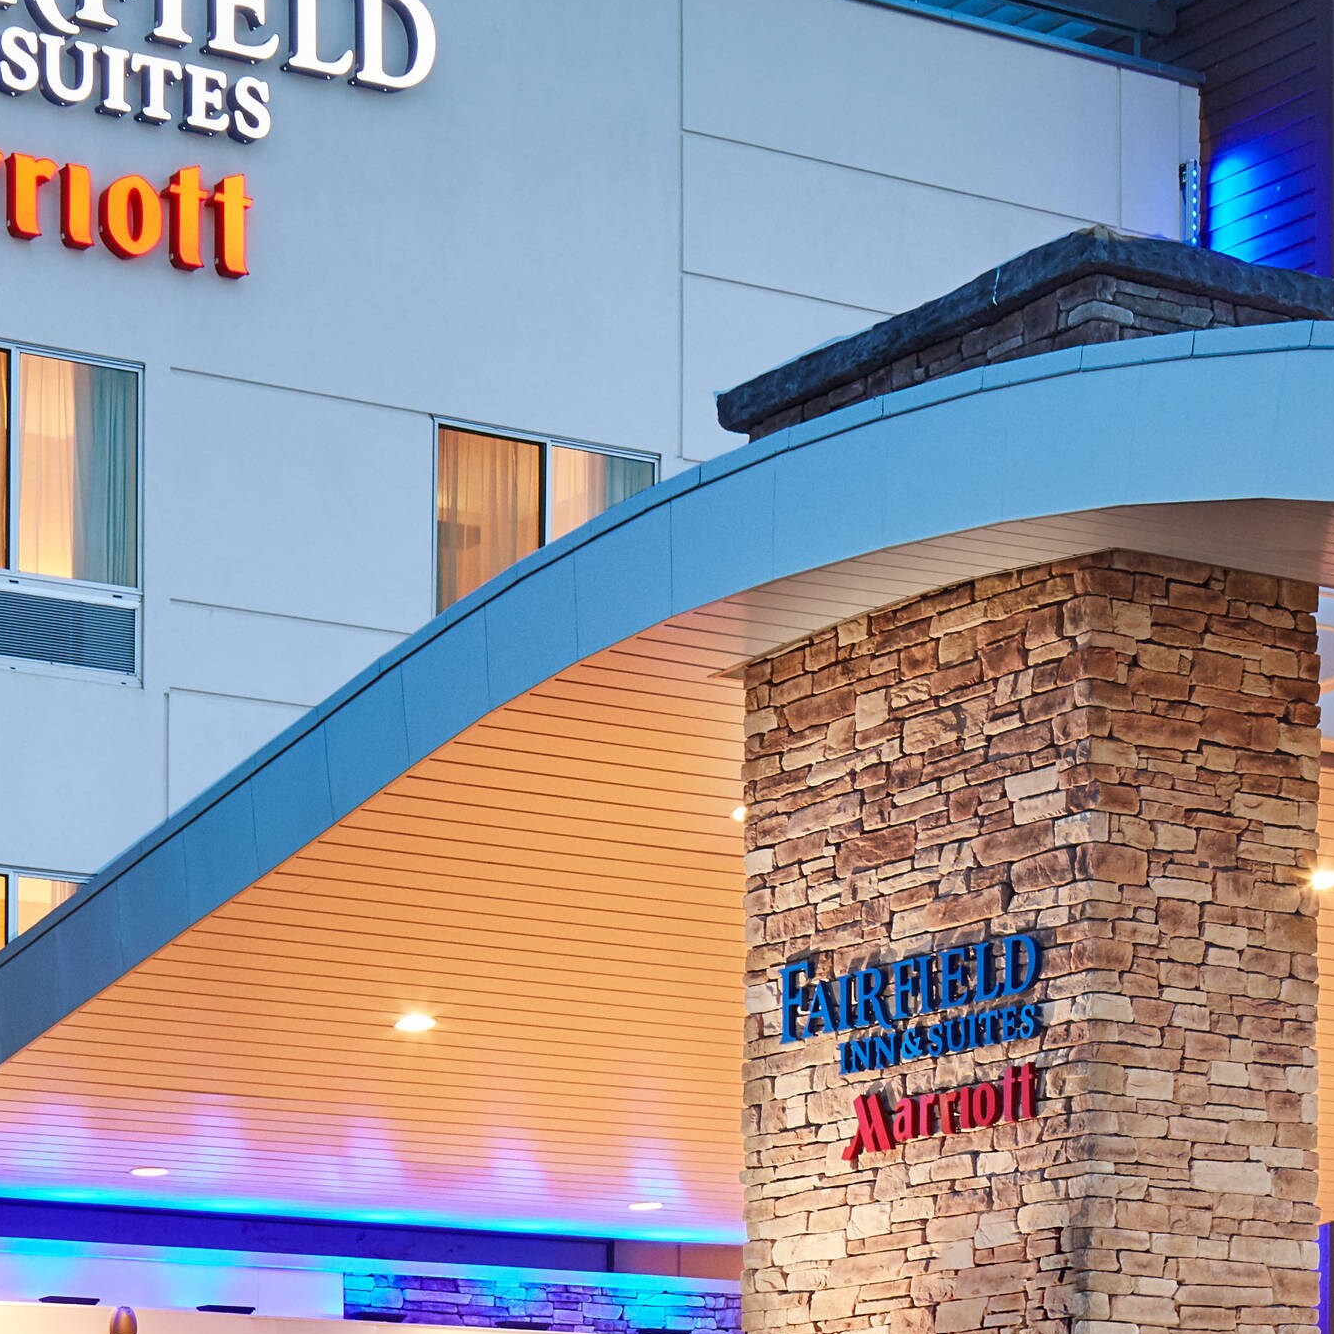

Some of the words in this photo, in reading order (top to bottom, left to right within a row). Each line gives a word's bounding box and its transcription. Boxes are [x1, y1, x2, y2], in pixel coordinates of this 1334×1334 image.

[779, 934, 1040, 1044] FAIRFIELD
[838, 1033, 896, 1075] INN
[900, 1026, 923, 1060] &
[928, 1004, 1036, 1056] SUITES
[842, 1062, 1037, 1161] Marriott
